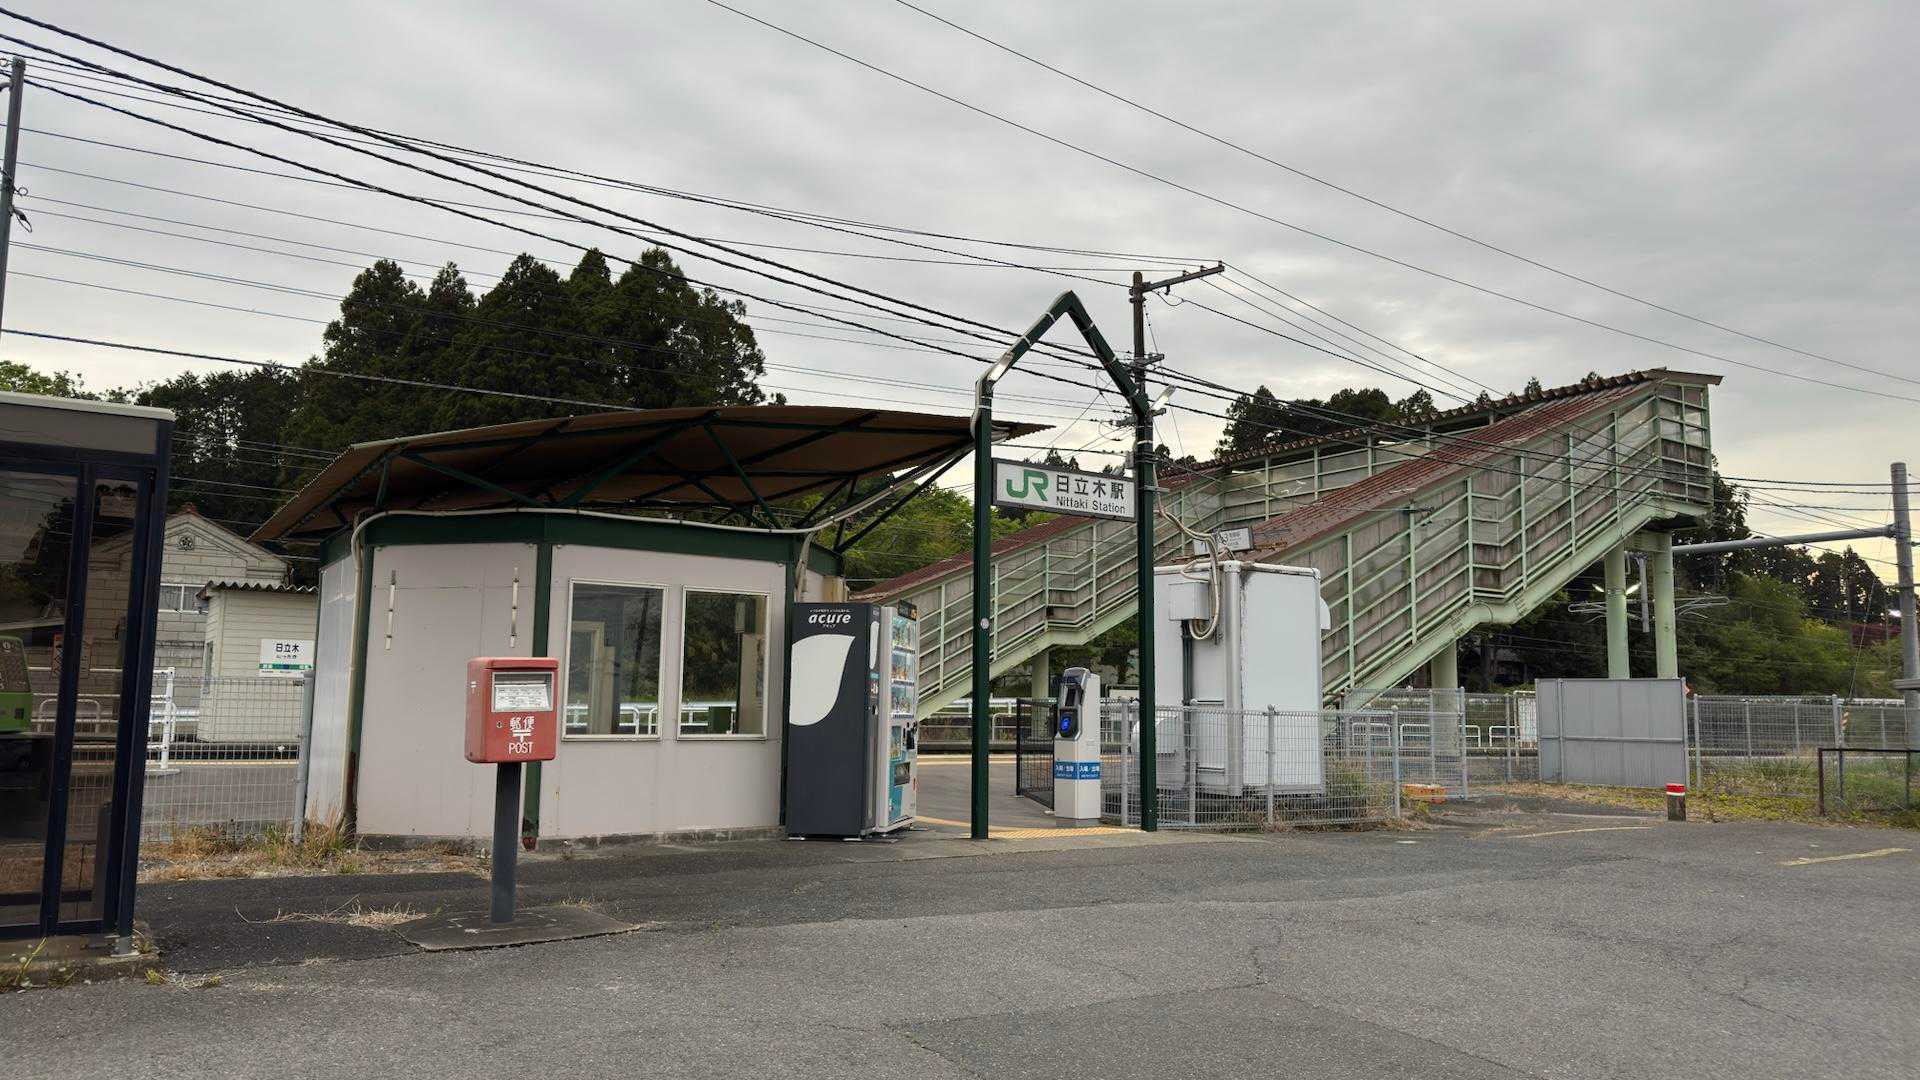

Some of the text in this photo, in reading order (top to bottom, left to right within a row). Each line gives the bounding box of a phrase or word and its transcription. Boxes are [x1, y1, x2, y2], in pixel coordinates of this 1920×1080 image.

[1006, 468, 1049, 502] JR
[1056, 474, 1125, 501] 日立木駅
[1055, 494, 1126, 515] Nittaki Station
[808, 613, 852, 624] acure
[276, 643, 299, 653] 日立木
[509, 716, 535, 731] 郵便
[509, 742, 534, 755] POST
